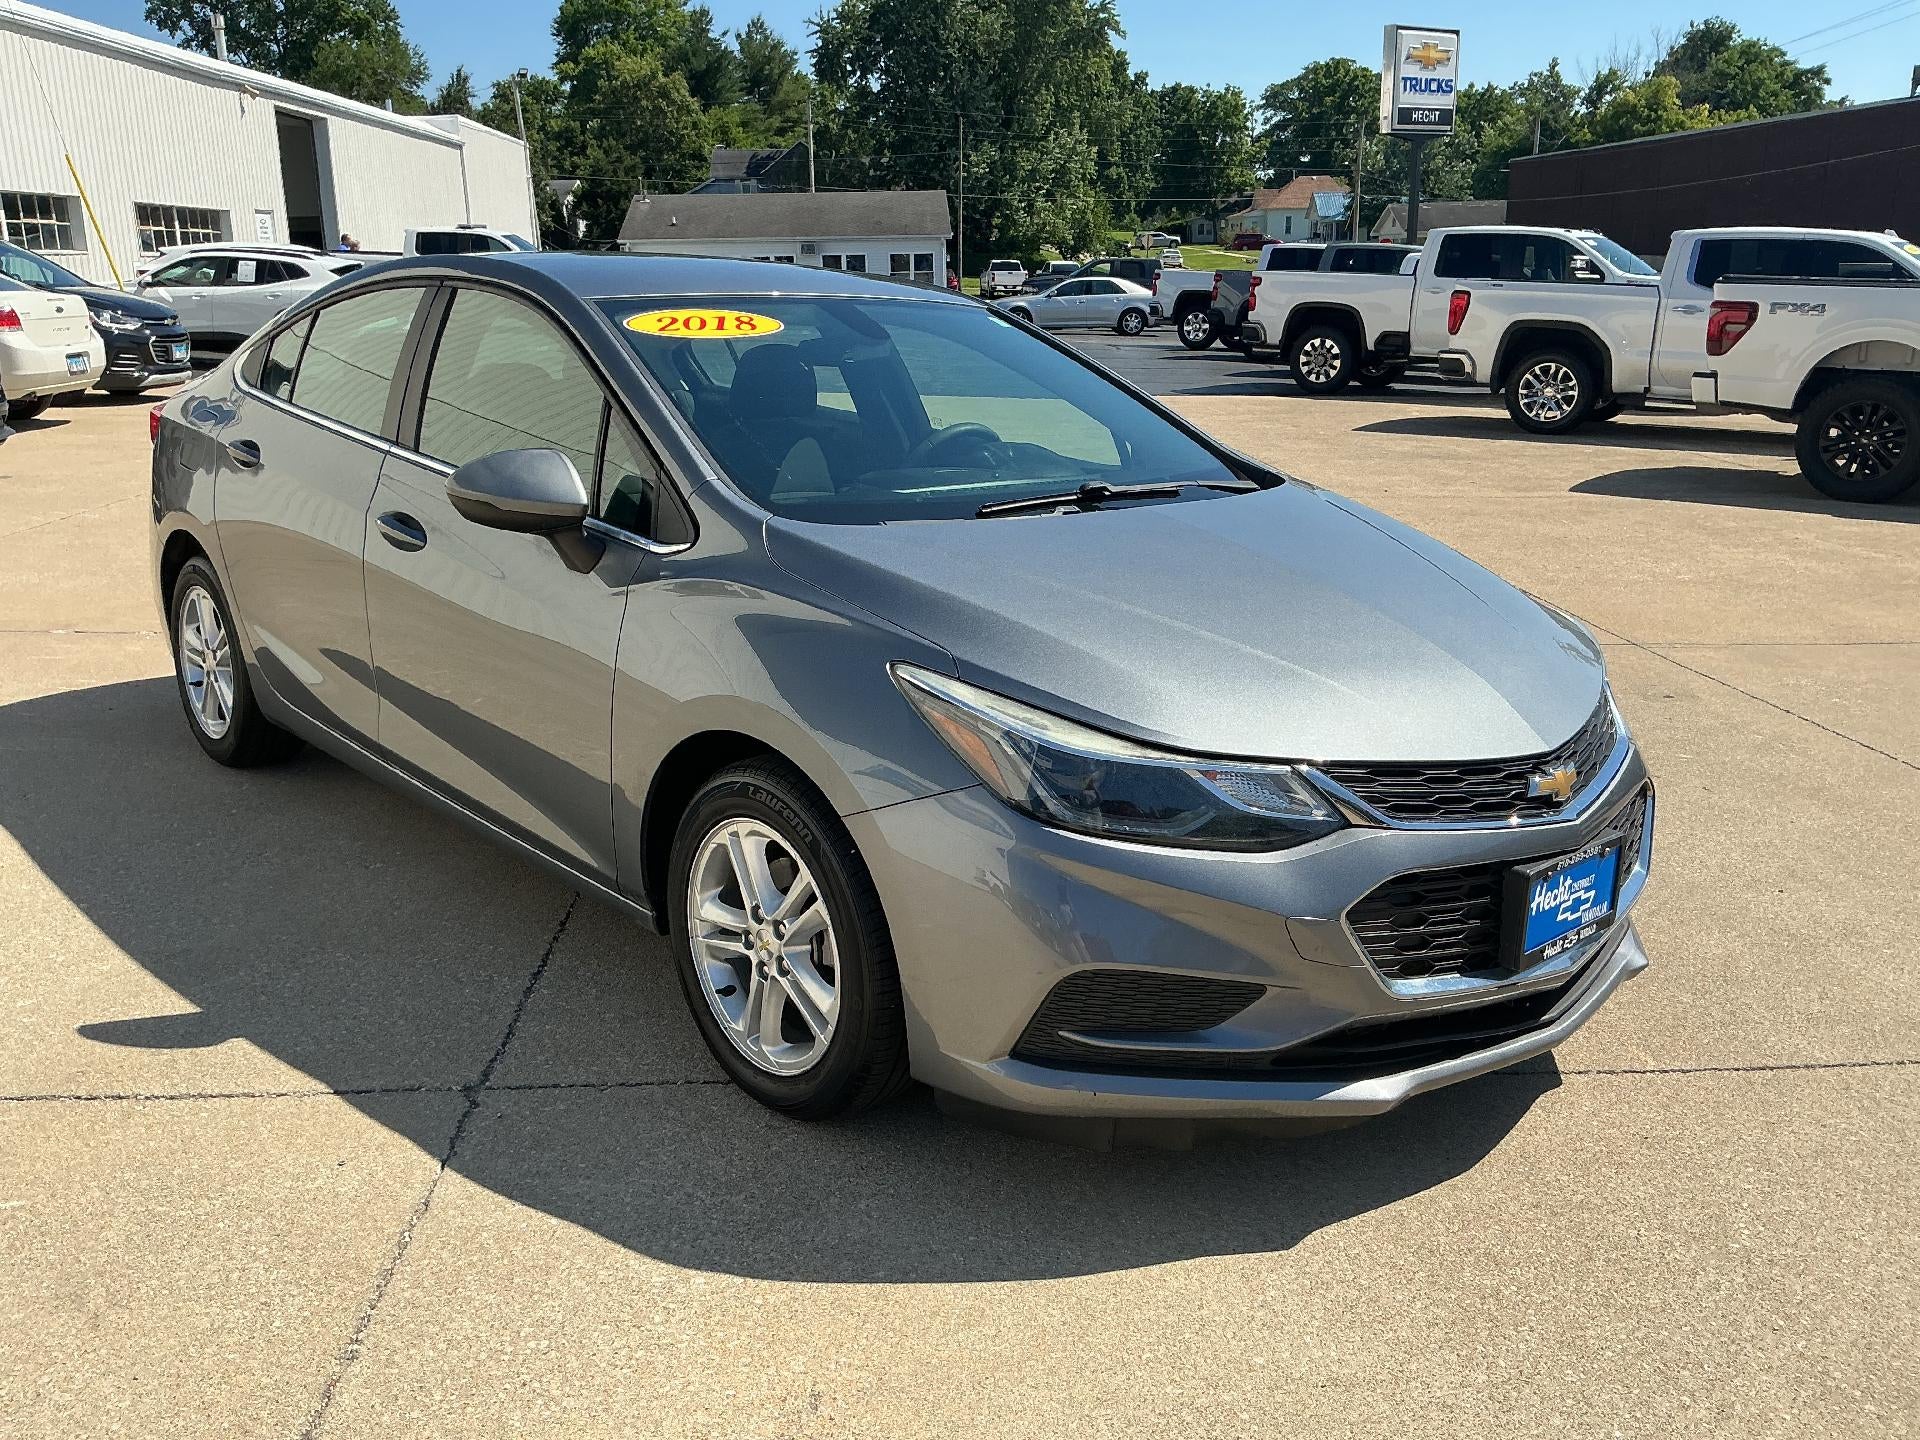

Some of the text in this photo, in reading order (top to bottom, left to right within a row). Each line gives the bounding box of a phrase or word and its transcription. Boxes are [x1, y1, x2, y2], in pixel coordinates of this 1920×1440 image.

[1401, 77, 1453, 94] TRUCKS
[1412, 110, 1440, 122] HECHT
[1769, 301, 1827, 314] FX4
[656, 315, 758, 332] 2018
[1531, 875, 1572, 916] Hecht
